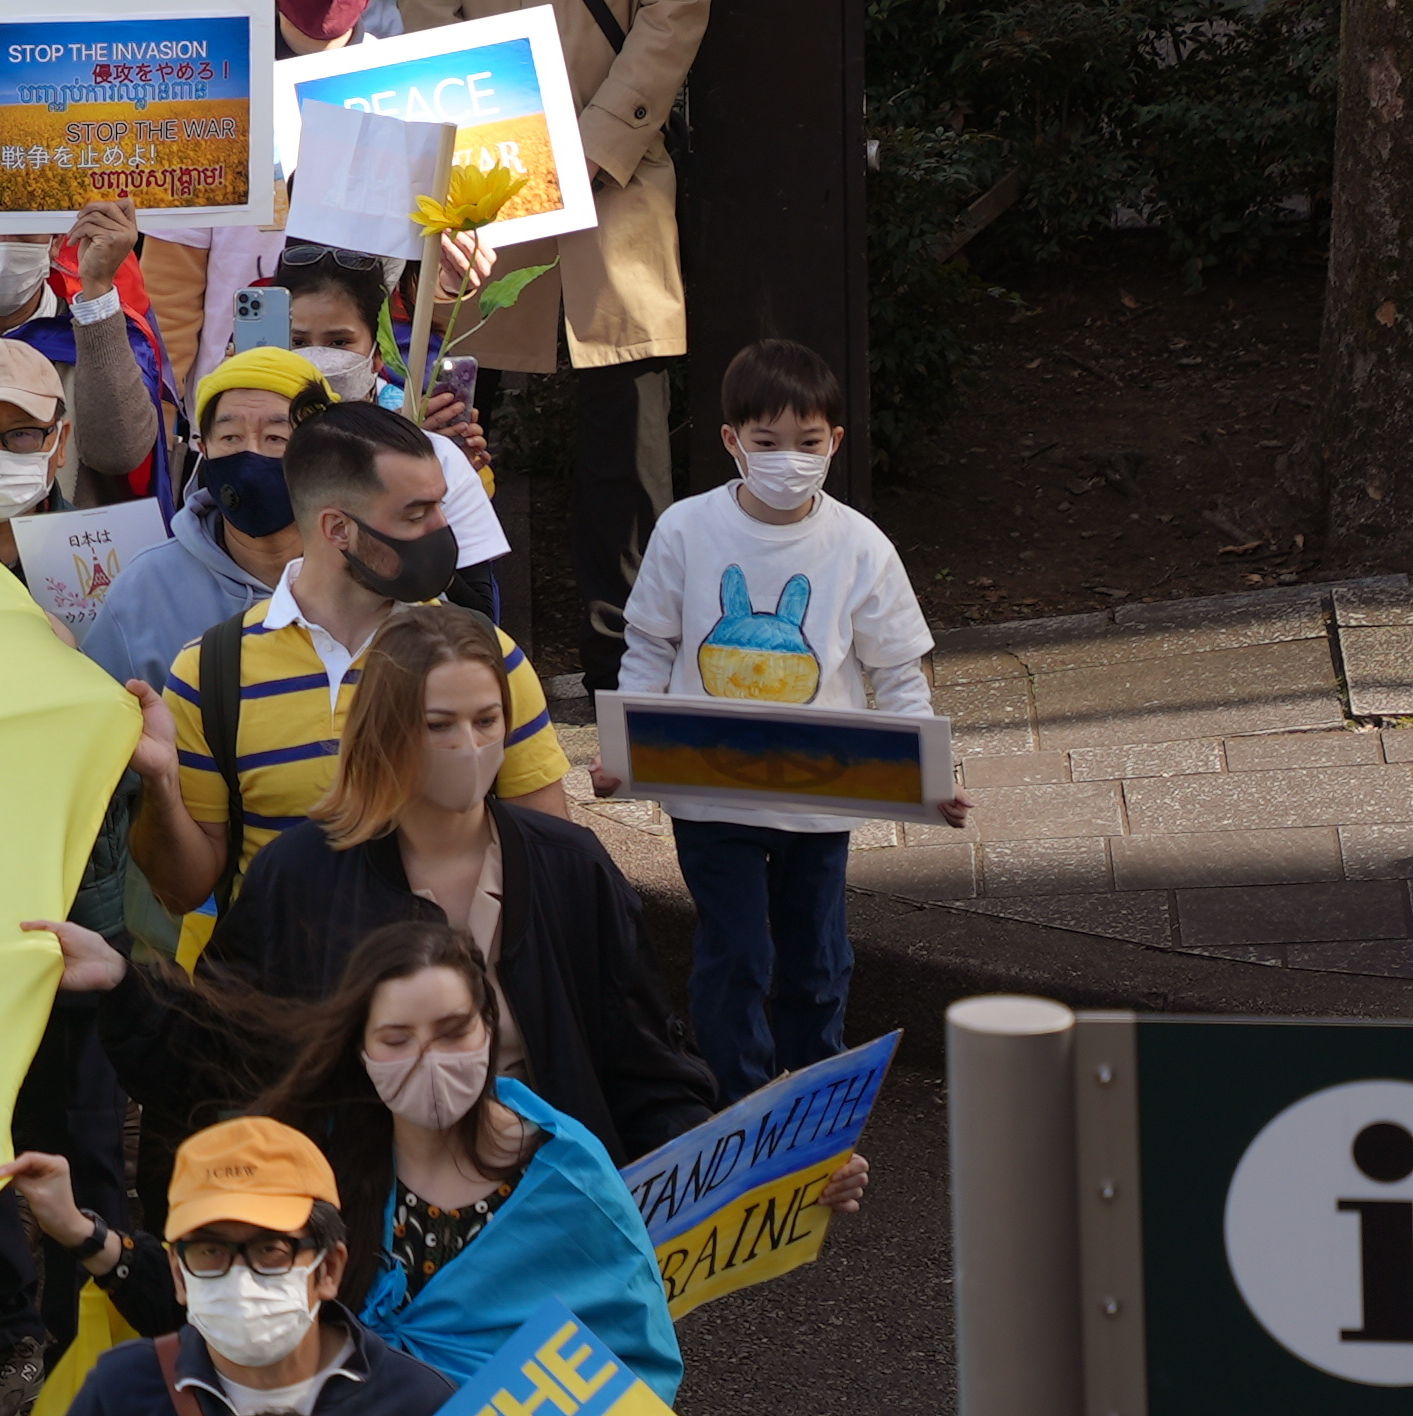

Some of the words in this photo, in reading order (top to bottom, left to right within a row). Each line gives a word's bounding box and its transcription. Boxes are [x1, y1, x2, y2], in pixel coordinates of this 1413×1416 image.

[8, 44, 64, 63] STOP
[68, 42, 108, 61] THE
[112, 40, 208, 61] INVASION
[65, 122, 129, 144] STOP
[134, 119, 178, 141] THE
[182, 117, 236, 139] WAR
[68, 529, 113, 548] 日本は
[65, 608, 98, 624] ウクラ
[631, 1129, 747, 1229] TAND
[749, 1068, 877, 1169] WITH
[657, 1173, 829, 1304] RAINE
[475, 1320, 620, 1416] HE
